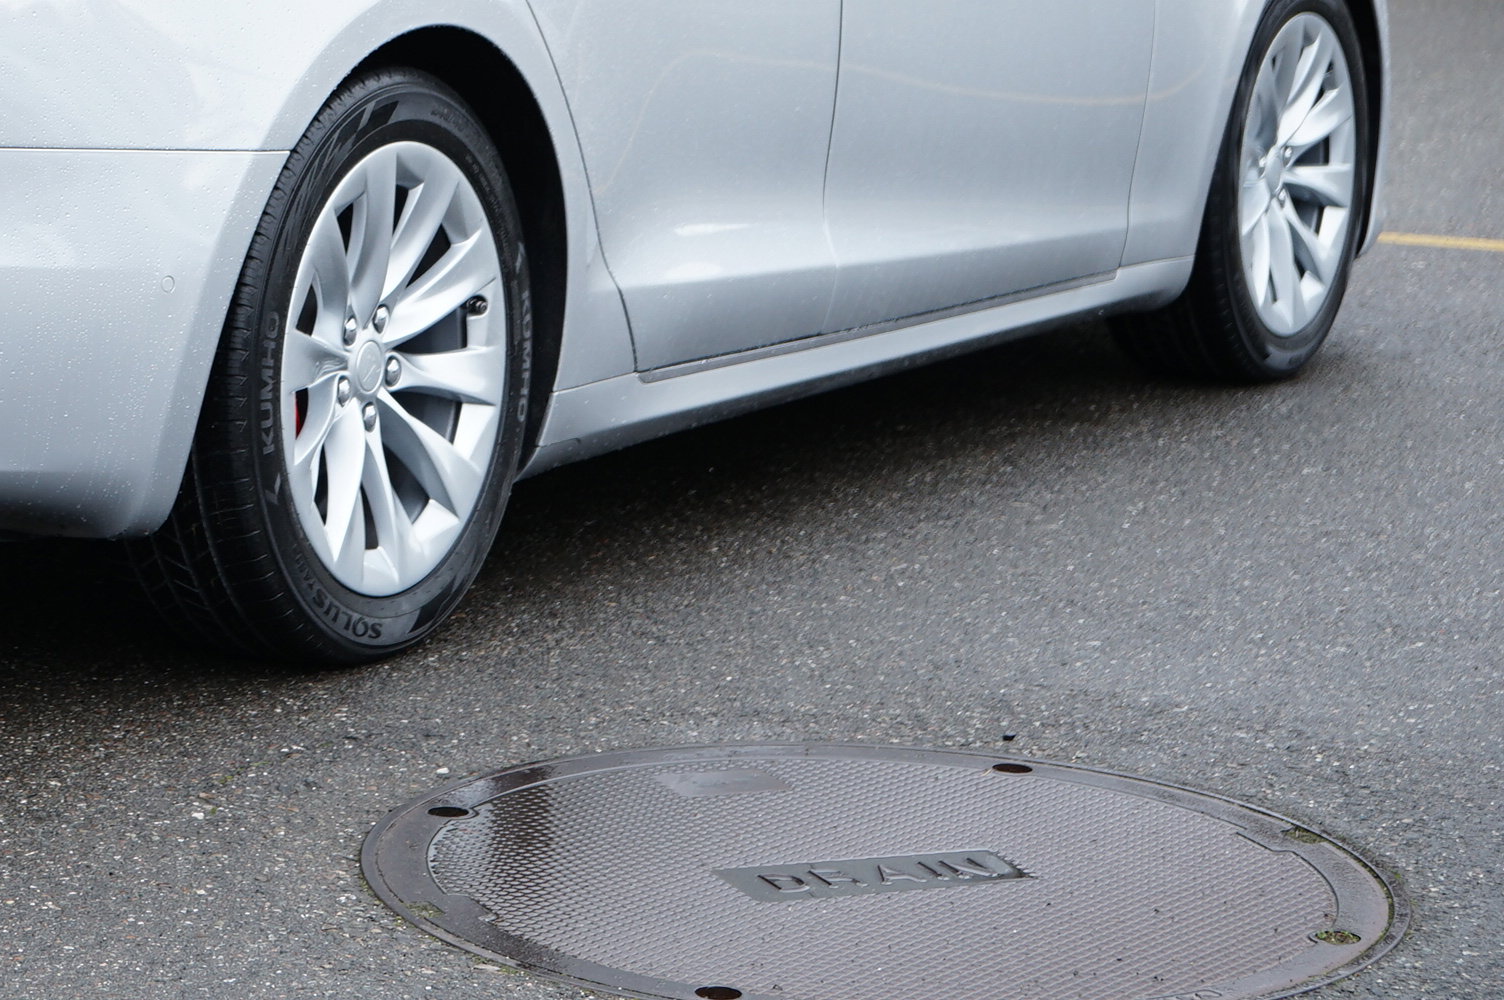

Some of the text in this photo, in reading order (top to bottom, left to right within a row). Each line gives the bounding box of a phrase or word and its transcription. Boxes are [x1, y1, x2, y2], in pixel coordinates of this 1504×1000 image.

[260, 311, 279, 455] KUMHO
[312, 588, 383, 639] SOLUS
[757, 857, 1002, 893] DRAIN
